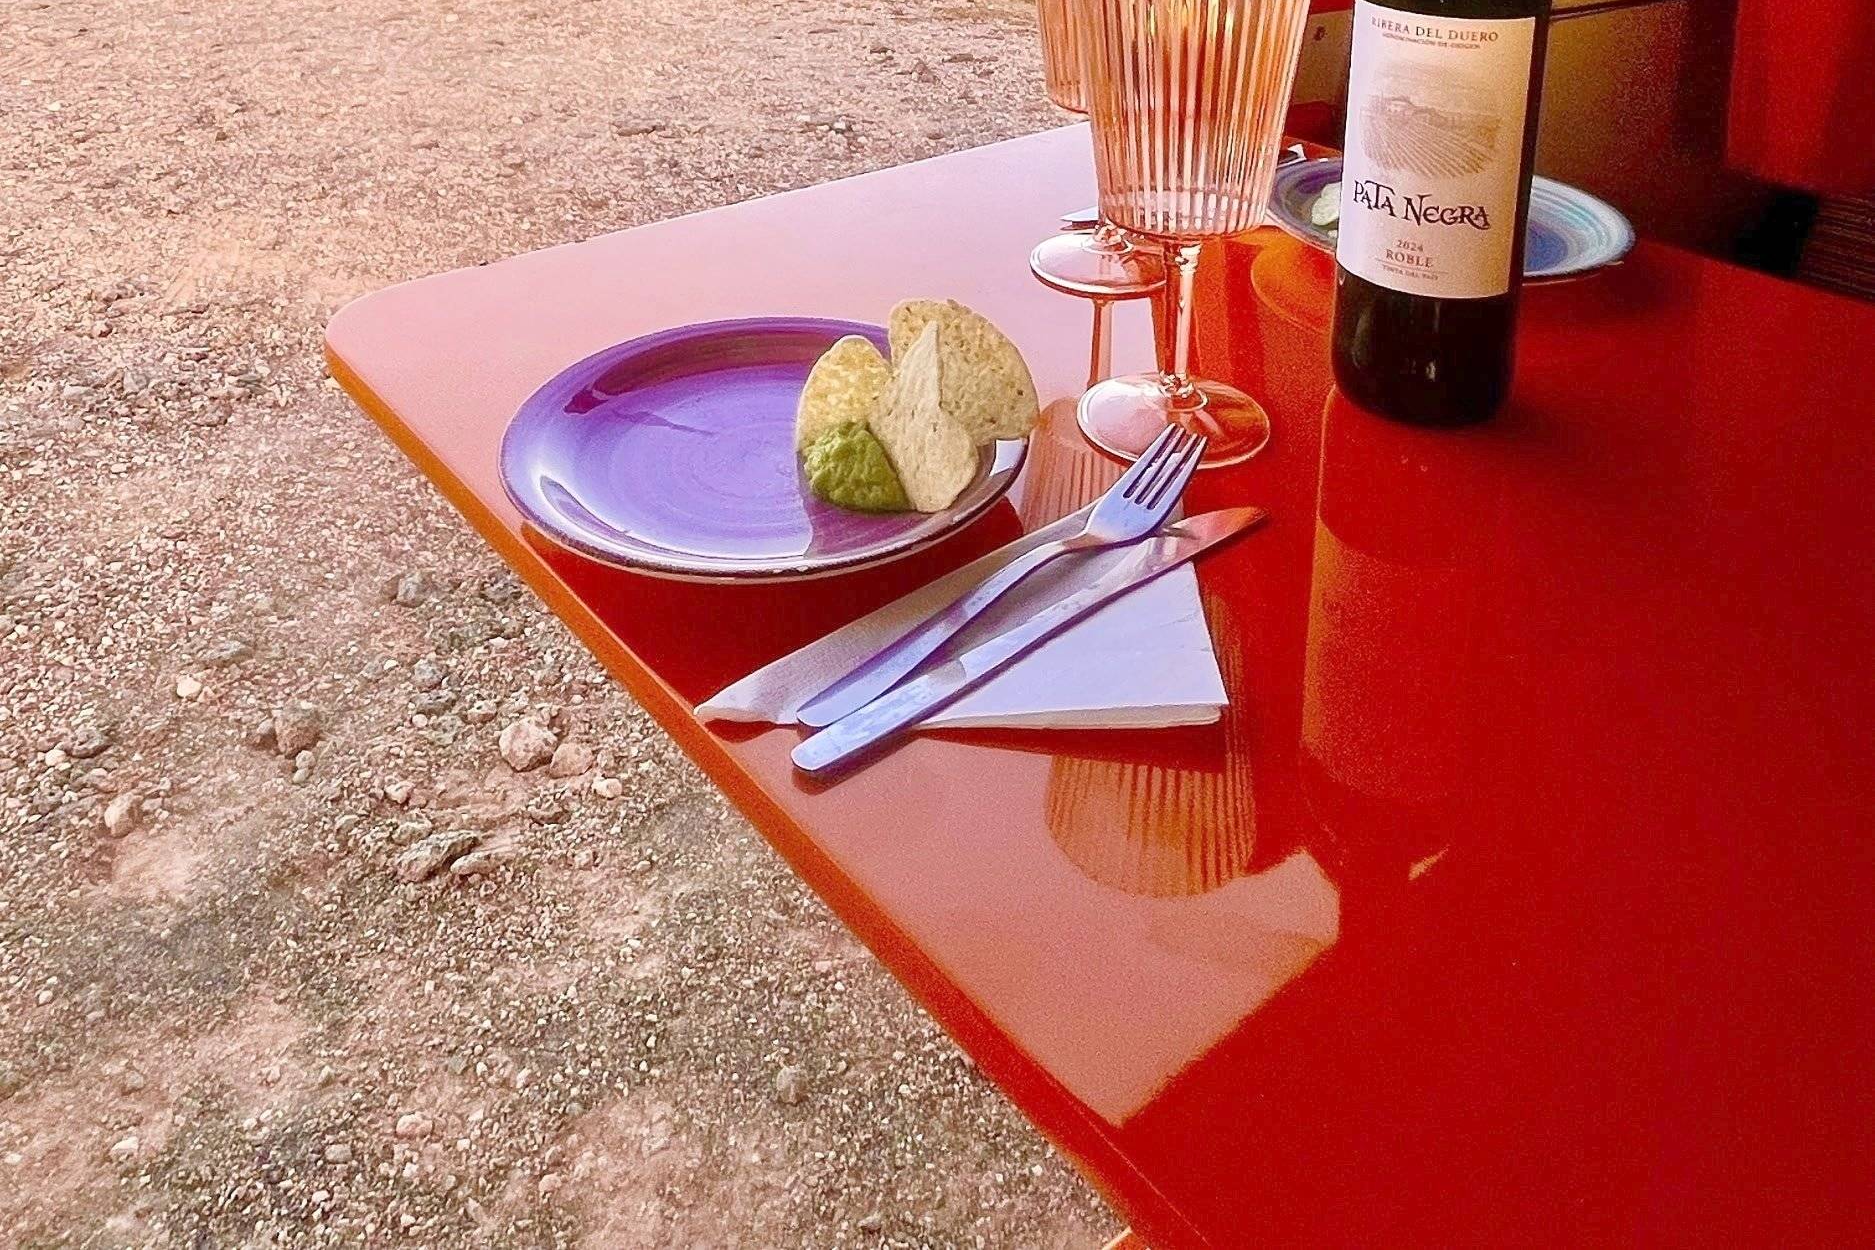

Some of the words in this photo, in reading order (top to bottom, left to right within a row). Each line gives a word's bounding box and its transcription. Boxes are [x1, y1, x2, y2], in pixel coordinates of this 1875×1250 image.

[1371, 17, 1410, 34] RIBERA
[1416, 26, 1443, 39] DEL
[1448, 29, 1499, 42] DUERO
[1353, 180, 1397, 217] PATA
[1402, 194, 1491, 230] NEGRA
[1396, 239, 1424, 252] 2024
[1386, 249, 1434, 268] ROBLE
